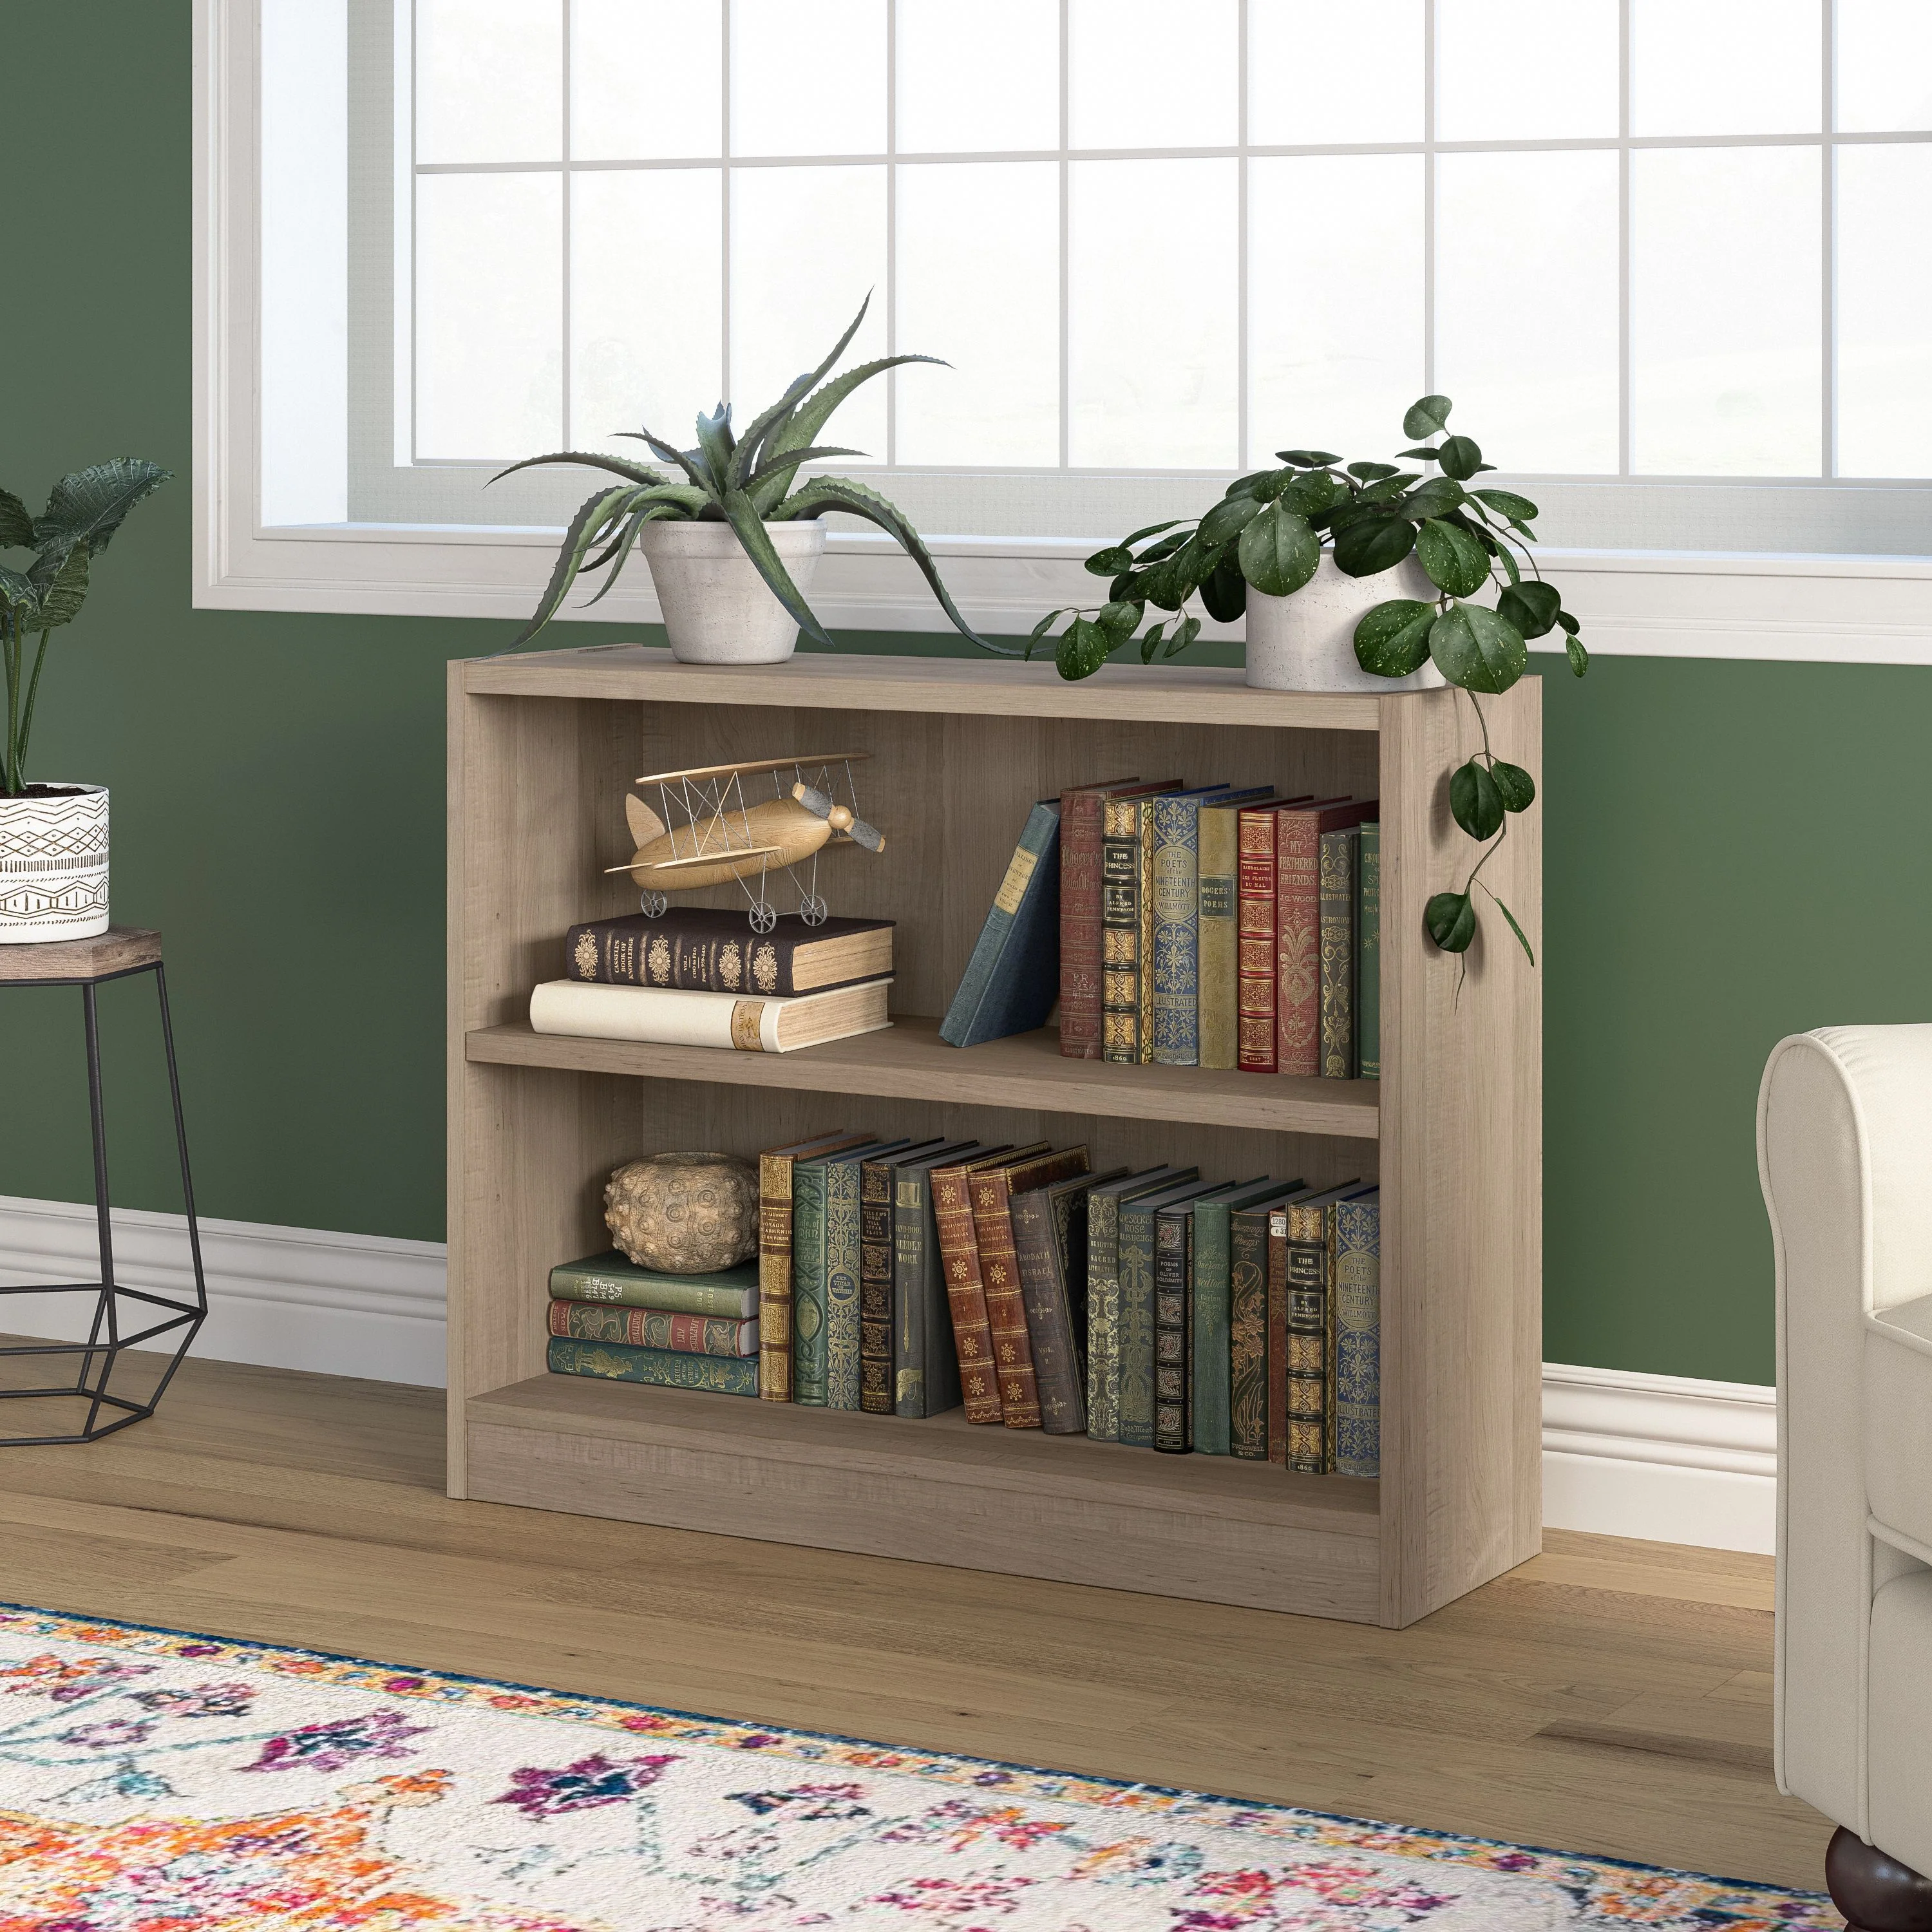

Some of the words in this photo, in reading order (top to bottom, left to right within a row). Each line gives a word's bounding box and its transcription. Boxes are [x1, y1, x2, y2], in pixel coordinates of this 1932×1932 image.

[1290, 841, 1302, 853] MY
[1161, 859, 1187, 868] POETS
[1280, 856, 1318, 870] FEATHERED
[1156, 876, 1195, 887] NINETEENTH
[1159, 888, 1190, 898] CENTURY
[1202, 886, 1231, 895] ROGERS'
[1159, 902, 1190, 911] WILLMOTT
[1204, 900, 1228, 908] POEMS
[621, 942, 626, 954] OF
[1072, 972, 1088, 983] PR
[1154, 998, 1197, 1007] ILLUSTRATED
[896, 1240, 922, 1251] NEEDLE
[1090, 1240, 1117, 1249] BEAUTIES
[898, 1253, 918, 1264] WORK
[1019, 1251, 1050, 1262] ABODATH
[1090, 1255, 1116, 1264] SACRED
[1345, 1265, 1372, 1275] POETS
[591, 1278, 600, 1299] B747
[600, 1281, 608, 1300] B74
[614, 1286, 623, 1299] PS
[1340, 1282, 1379, 1295] NINETEENTH
[1342, 1294, 1376, 1305] CENTURY
[1342, 1309, 1375, 1318] WILLMOTT
[690, 1318, 699, 1352] JAPANESE
